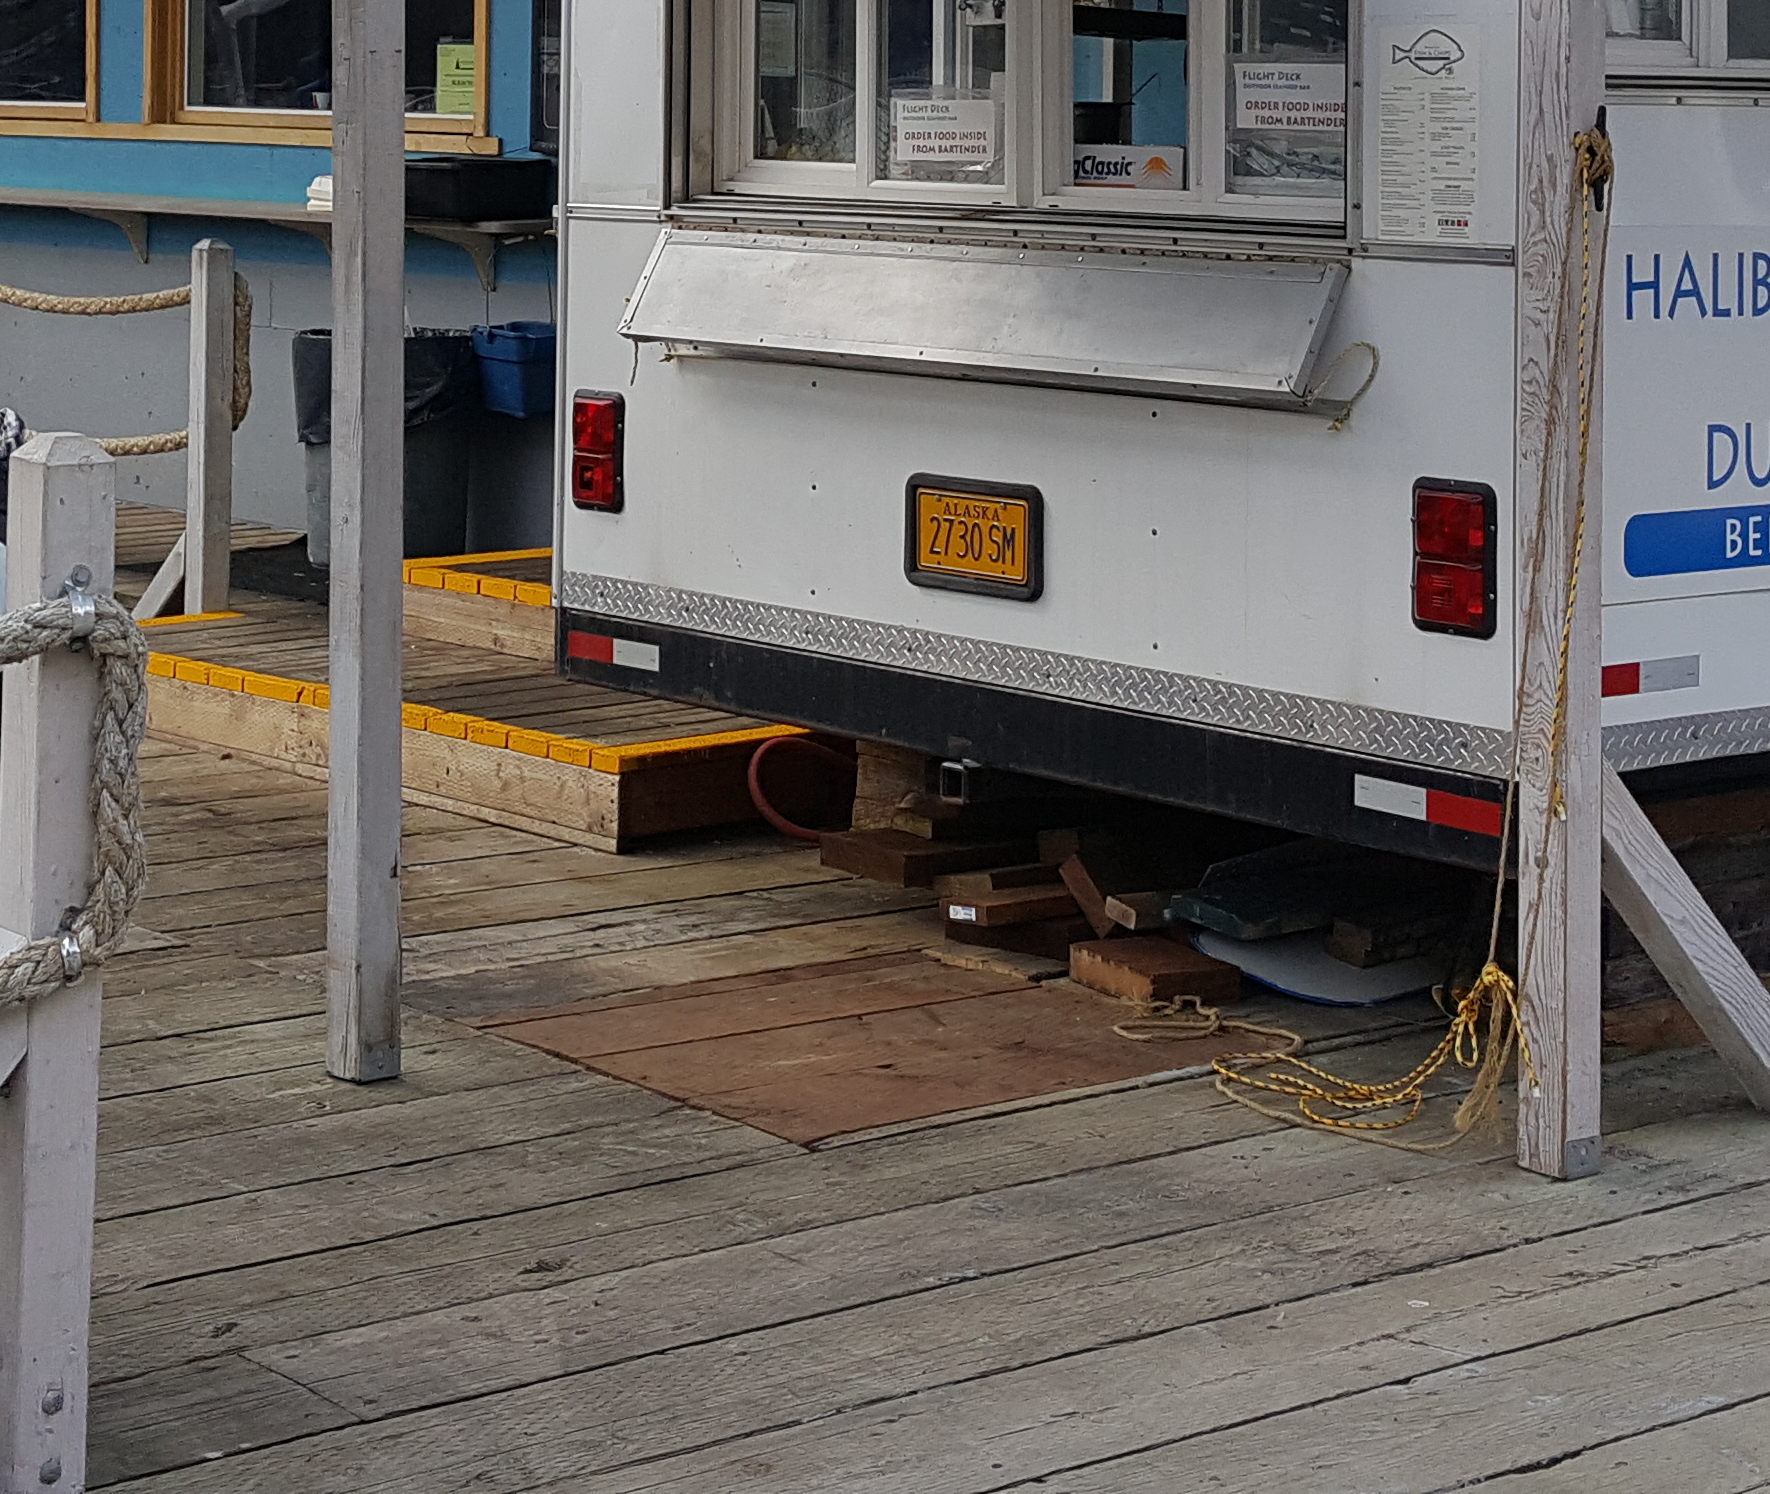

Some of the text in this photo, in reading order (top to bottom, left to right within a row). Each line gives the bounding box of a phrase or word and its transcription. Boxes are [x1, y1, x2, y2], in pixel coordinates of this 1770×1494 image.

[1243, 71, 1302, 81] FLIGHT DECK
[1245, 100, 1346, 113] ORDER FOOD INSIDE
[1255, 115, 1346, 128] FROM BARTENDER
[904, 131, 987, 141] ORDER FOOD INSIDE
[912, 144, 988, 154] FROM BARTENDER
[943, 501, 1001, 521] ALASKA
[929, 514, 1017, 566] 2730 SM
